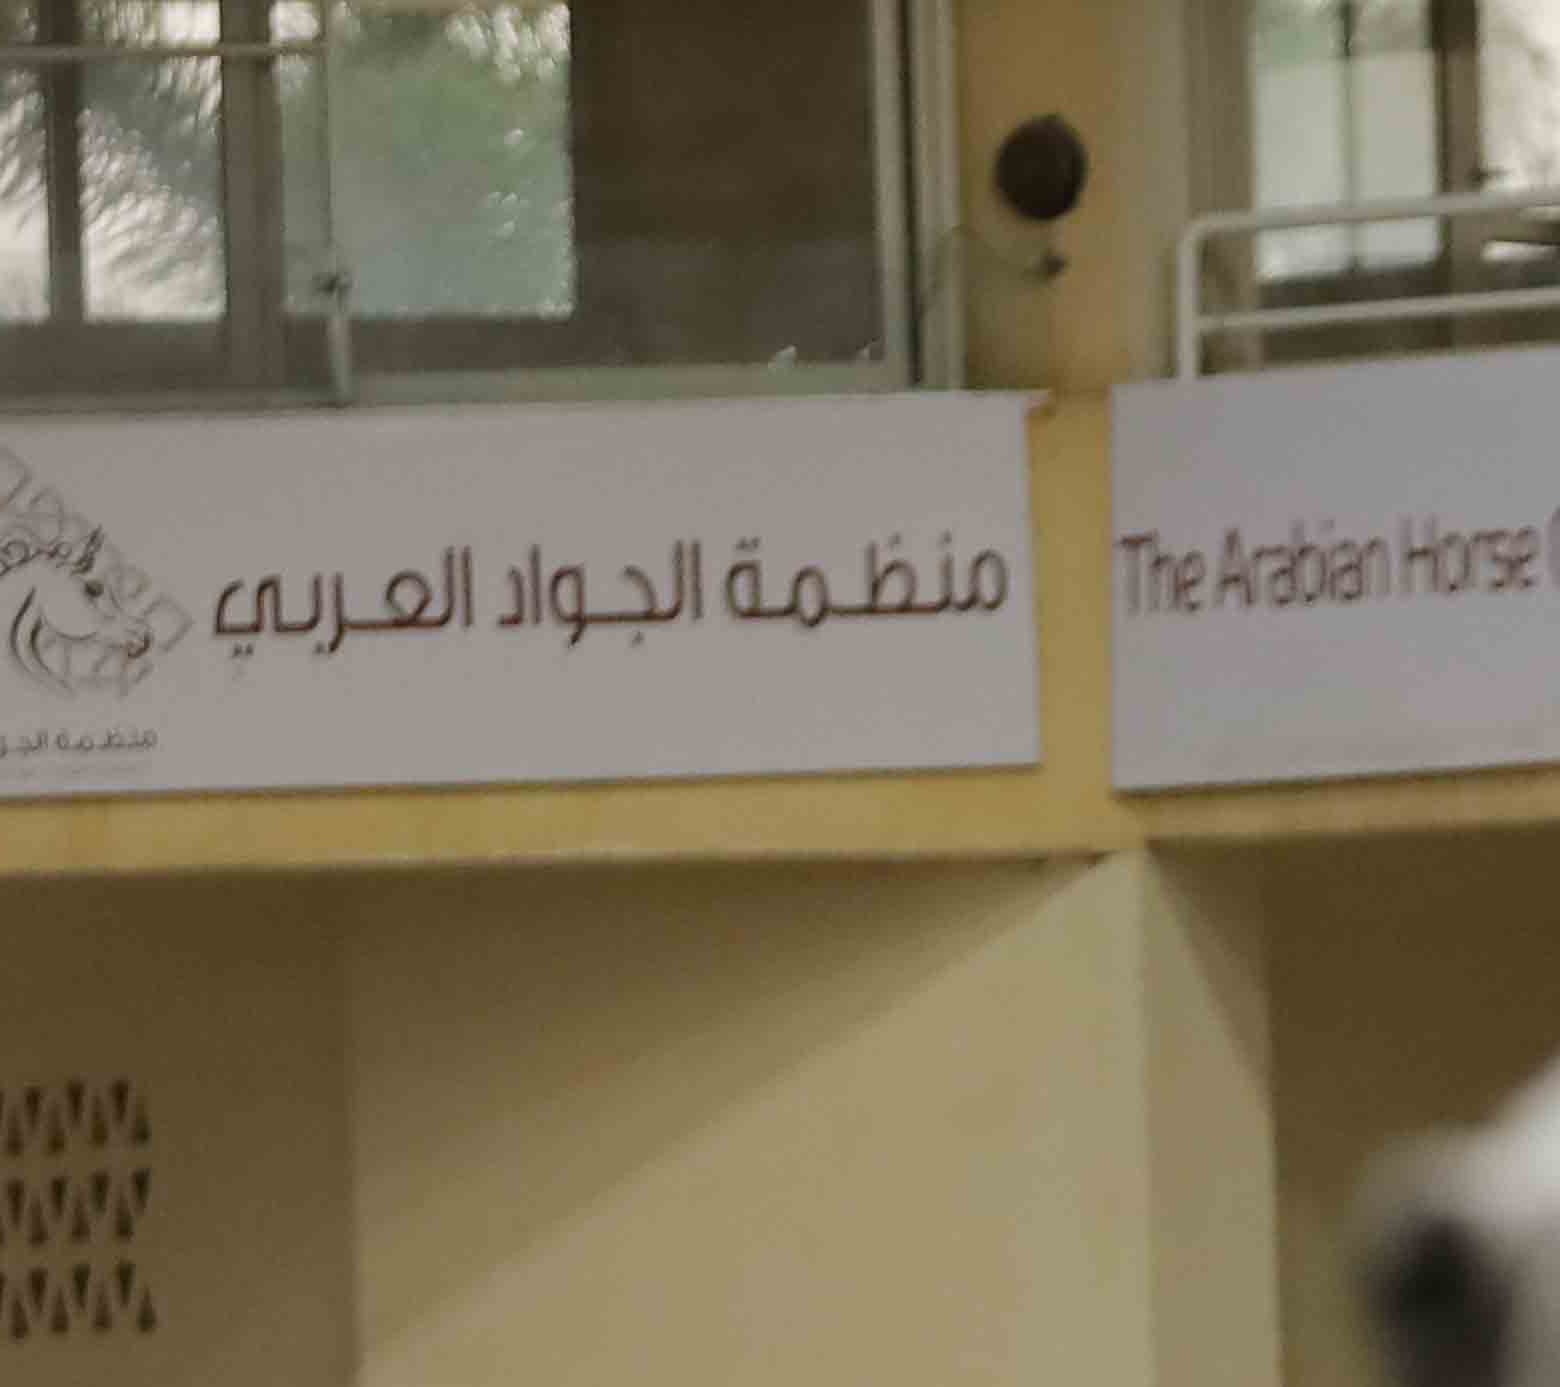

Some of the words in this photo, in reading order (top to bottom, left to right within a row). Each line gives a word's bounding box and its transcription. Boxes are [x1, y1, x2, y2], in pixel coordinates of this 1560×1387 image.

[212, 544, 474, 660] العربي
[496, 538, 704, 648] الجواد
[723, 530, 1009, 630] منظمة
[1117, 528, 1206, 616] The
[1213, 519, 1388, 609] Arabian
[1395, 513, 1540, 596] Horse
